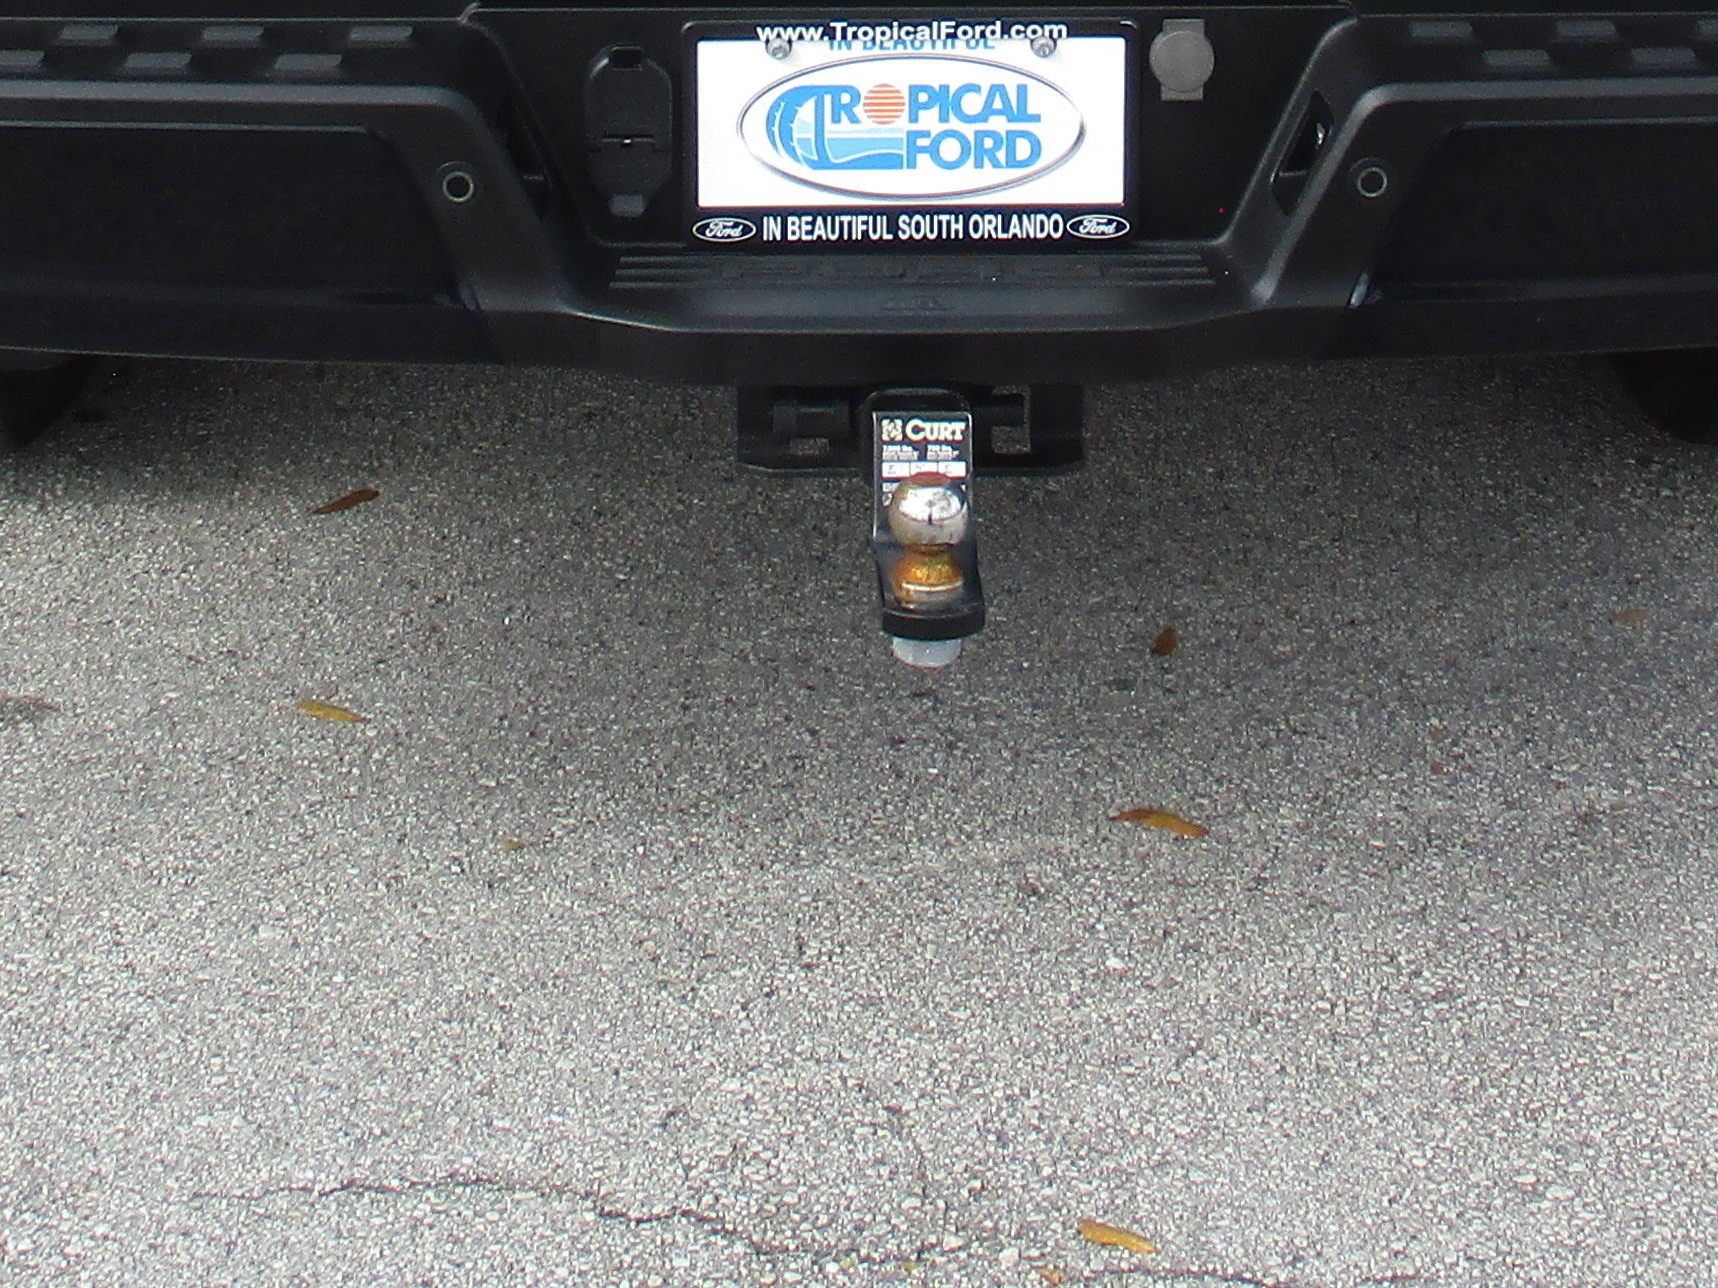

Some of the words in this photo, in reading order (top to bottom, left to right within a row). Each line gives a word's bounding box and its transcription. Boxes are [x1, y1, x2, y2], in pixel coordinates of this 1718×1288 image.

[756, 20, 1068, 43] www.TropicalFord.com
[767, 83, 1041, 125] TROPICAL
[906, 129, 1042, 170] FORD
[762, 215, 782, 241] IN
[787, 215, 893, 241] BEAUTIFUL
[898, 214, 964, 240] SOUTH
[969, 213, 1064, 240] ORLANDO
[905, 418, 966, 442] CURT
